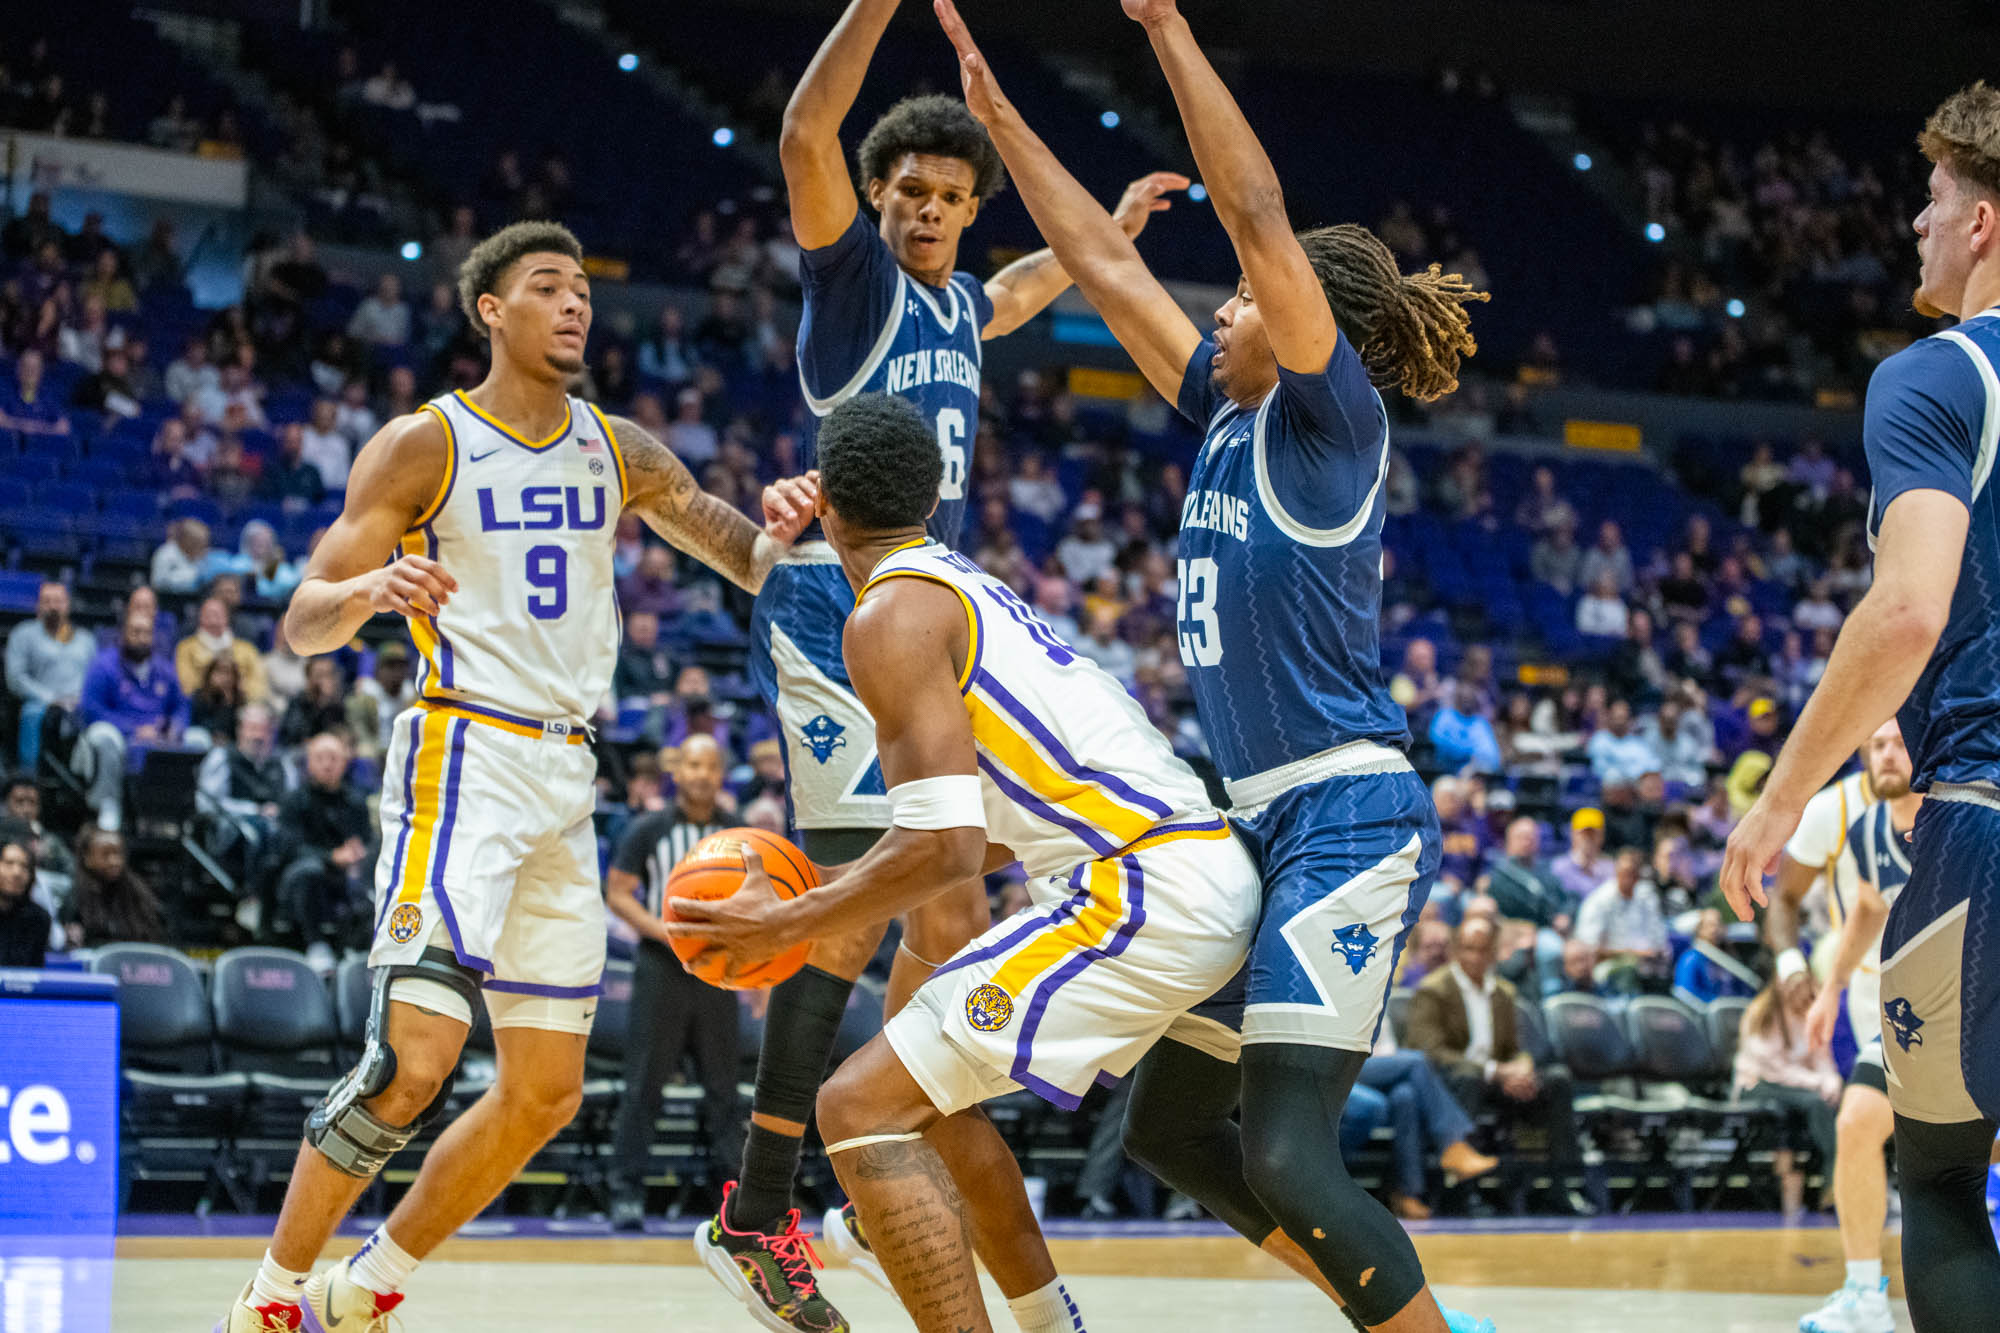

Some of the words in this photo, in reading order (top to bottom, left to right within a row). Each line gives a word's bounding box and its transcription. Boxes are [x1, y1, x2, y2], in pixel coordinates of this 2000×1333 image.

[887, 350, 932, 396] NEW
[936, 408, 965, 500] 6
[477, 486, 606, 533] LSU
[525, 545, 568, 620] 9
[1177, 557, 1224, 667] 23
[547, 721, 568, 735] LSU
